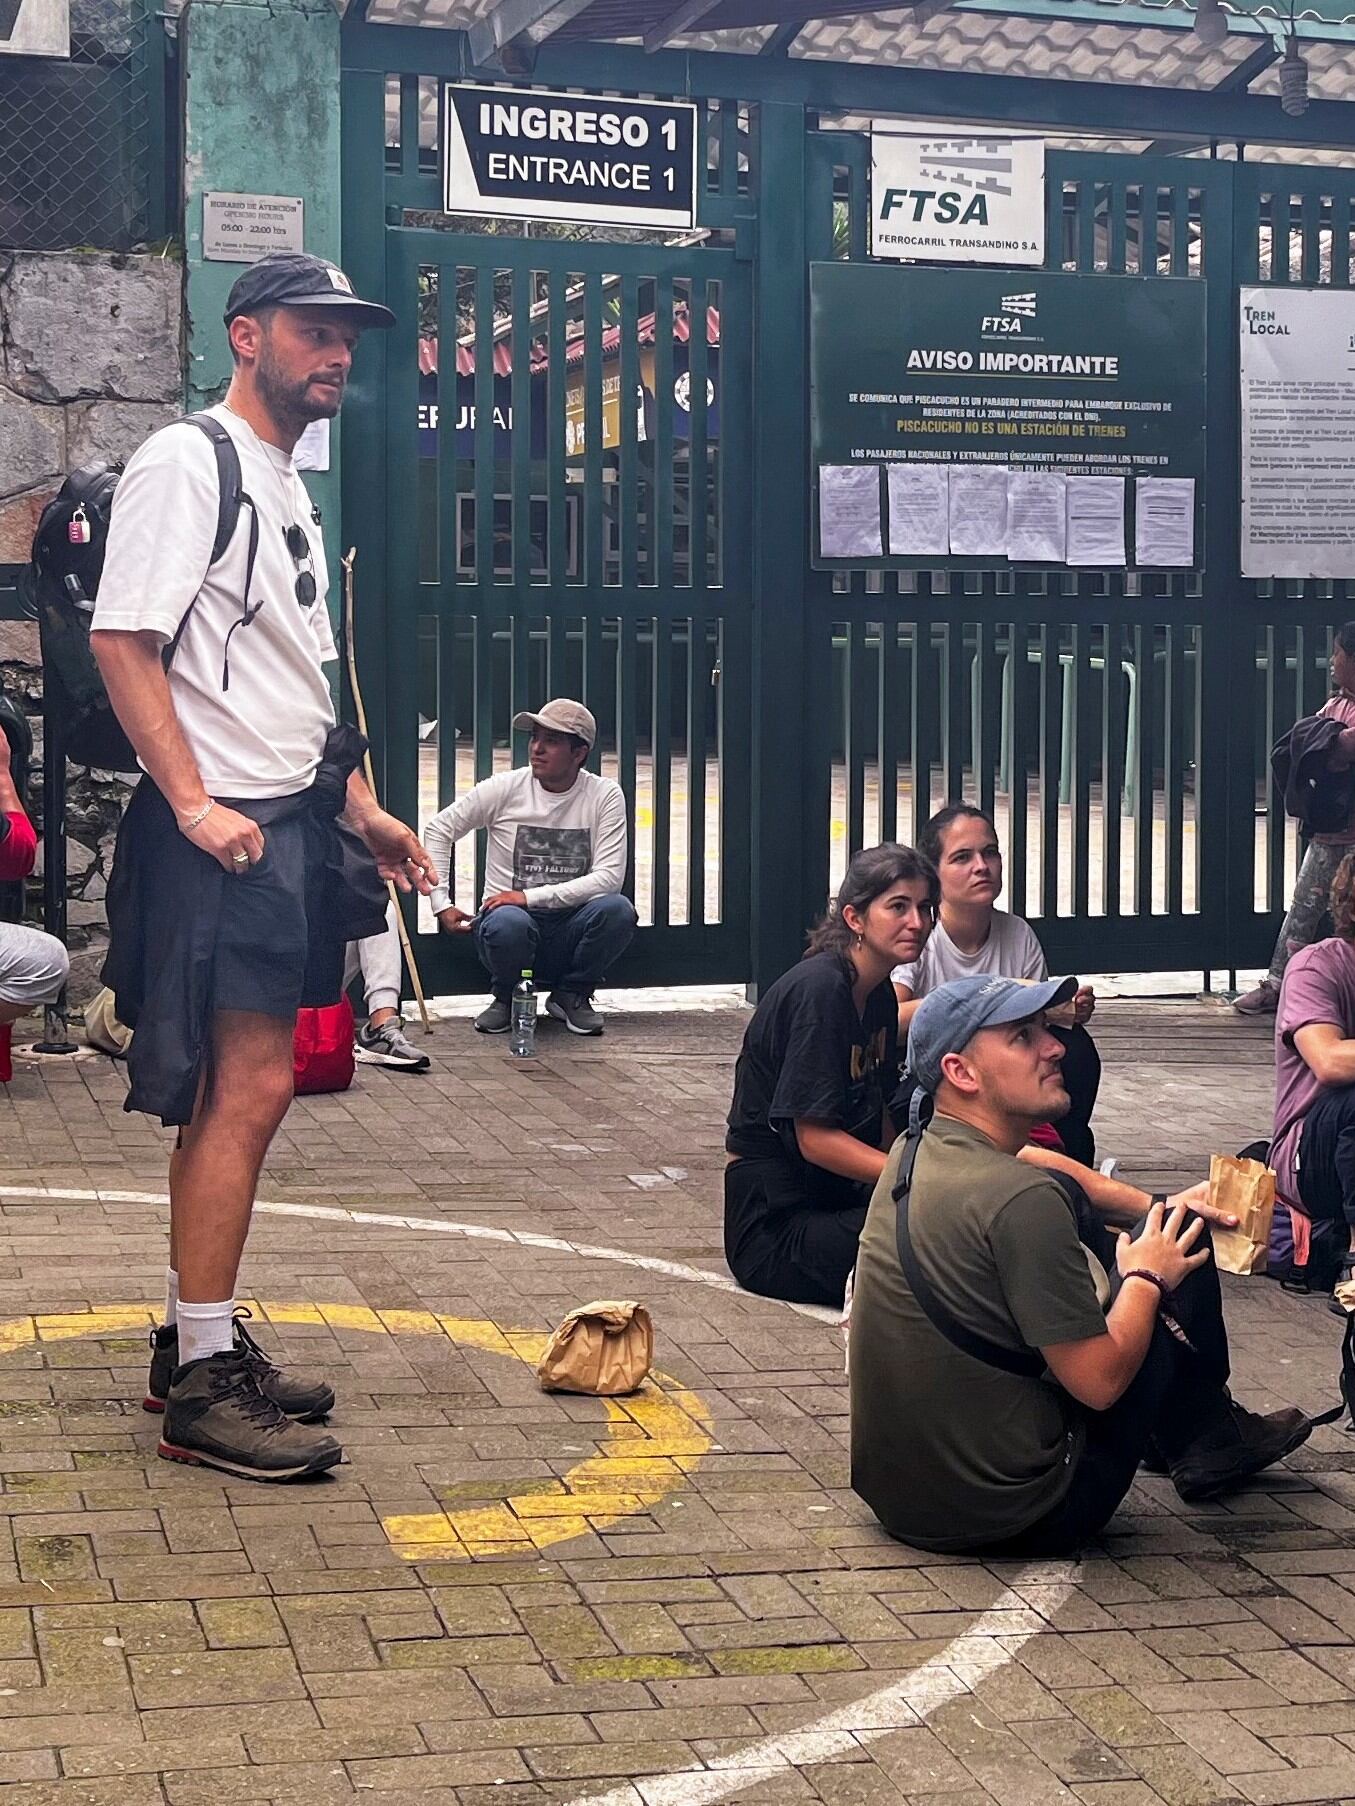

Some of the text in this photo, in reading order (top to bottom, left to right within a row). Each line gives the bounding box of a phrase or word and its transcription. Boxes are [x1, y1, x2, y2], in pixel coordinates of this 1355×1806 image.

[480, 103, 677, 151] INGRESO 1
[488, 153, 675, 191] ENTRANCE 1
[879, 188, 989, 226] FTSA
[878, 234, 946, 247] FERROCARRIL
[949, 238, 1019, 250] TRANSANDINO
[1244, 306, 1275, 321] TREN
[981, 316, 1022, 333] FTSA
[1249, 320, 1291, 335] LOCAL
[906, 350, 1120, 376] AVISO IMPORTANTE
[899, 394, 913, 404] QUE
[915, 395, 960, 406] PISCACUCHO
[960, 396, 970, 406] ES
[896, 419, 1127, 438] PISCACUCHO NO ES UNA ESTACIÓN DE TRENES
[850, 448, 865, 459] LOS
[865, 448, 907, 459] PASAJEROS
[952, 450, 958, 460] Y
[959, 450, 1009, 461] EXTRANJEROS
[1117, 454, 1132, 464] LOS
